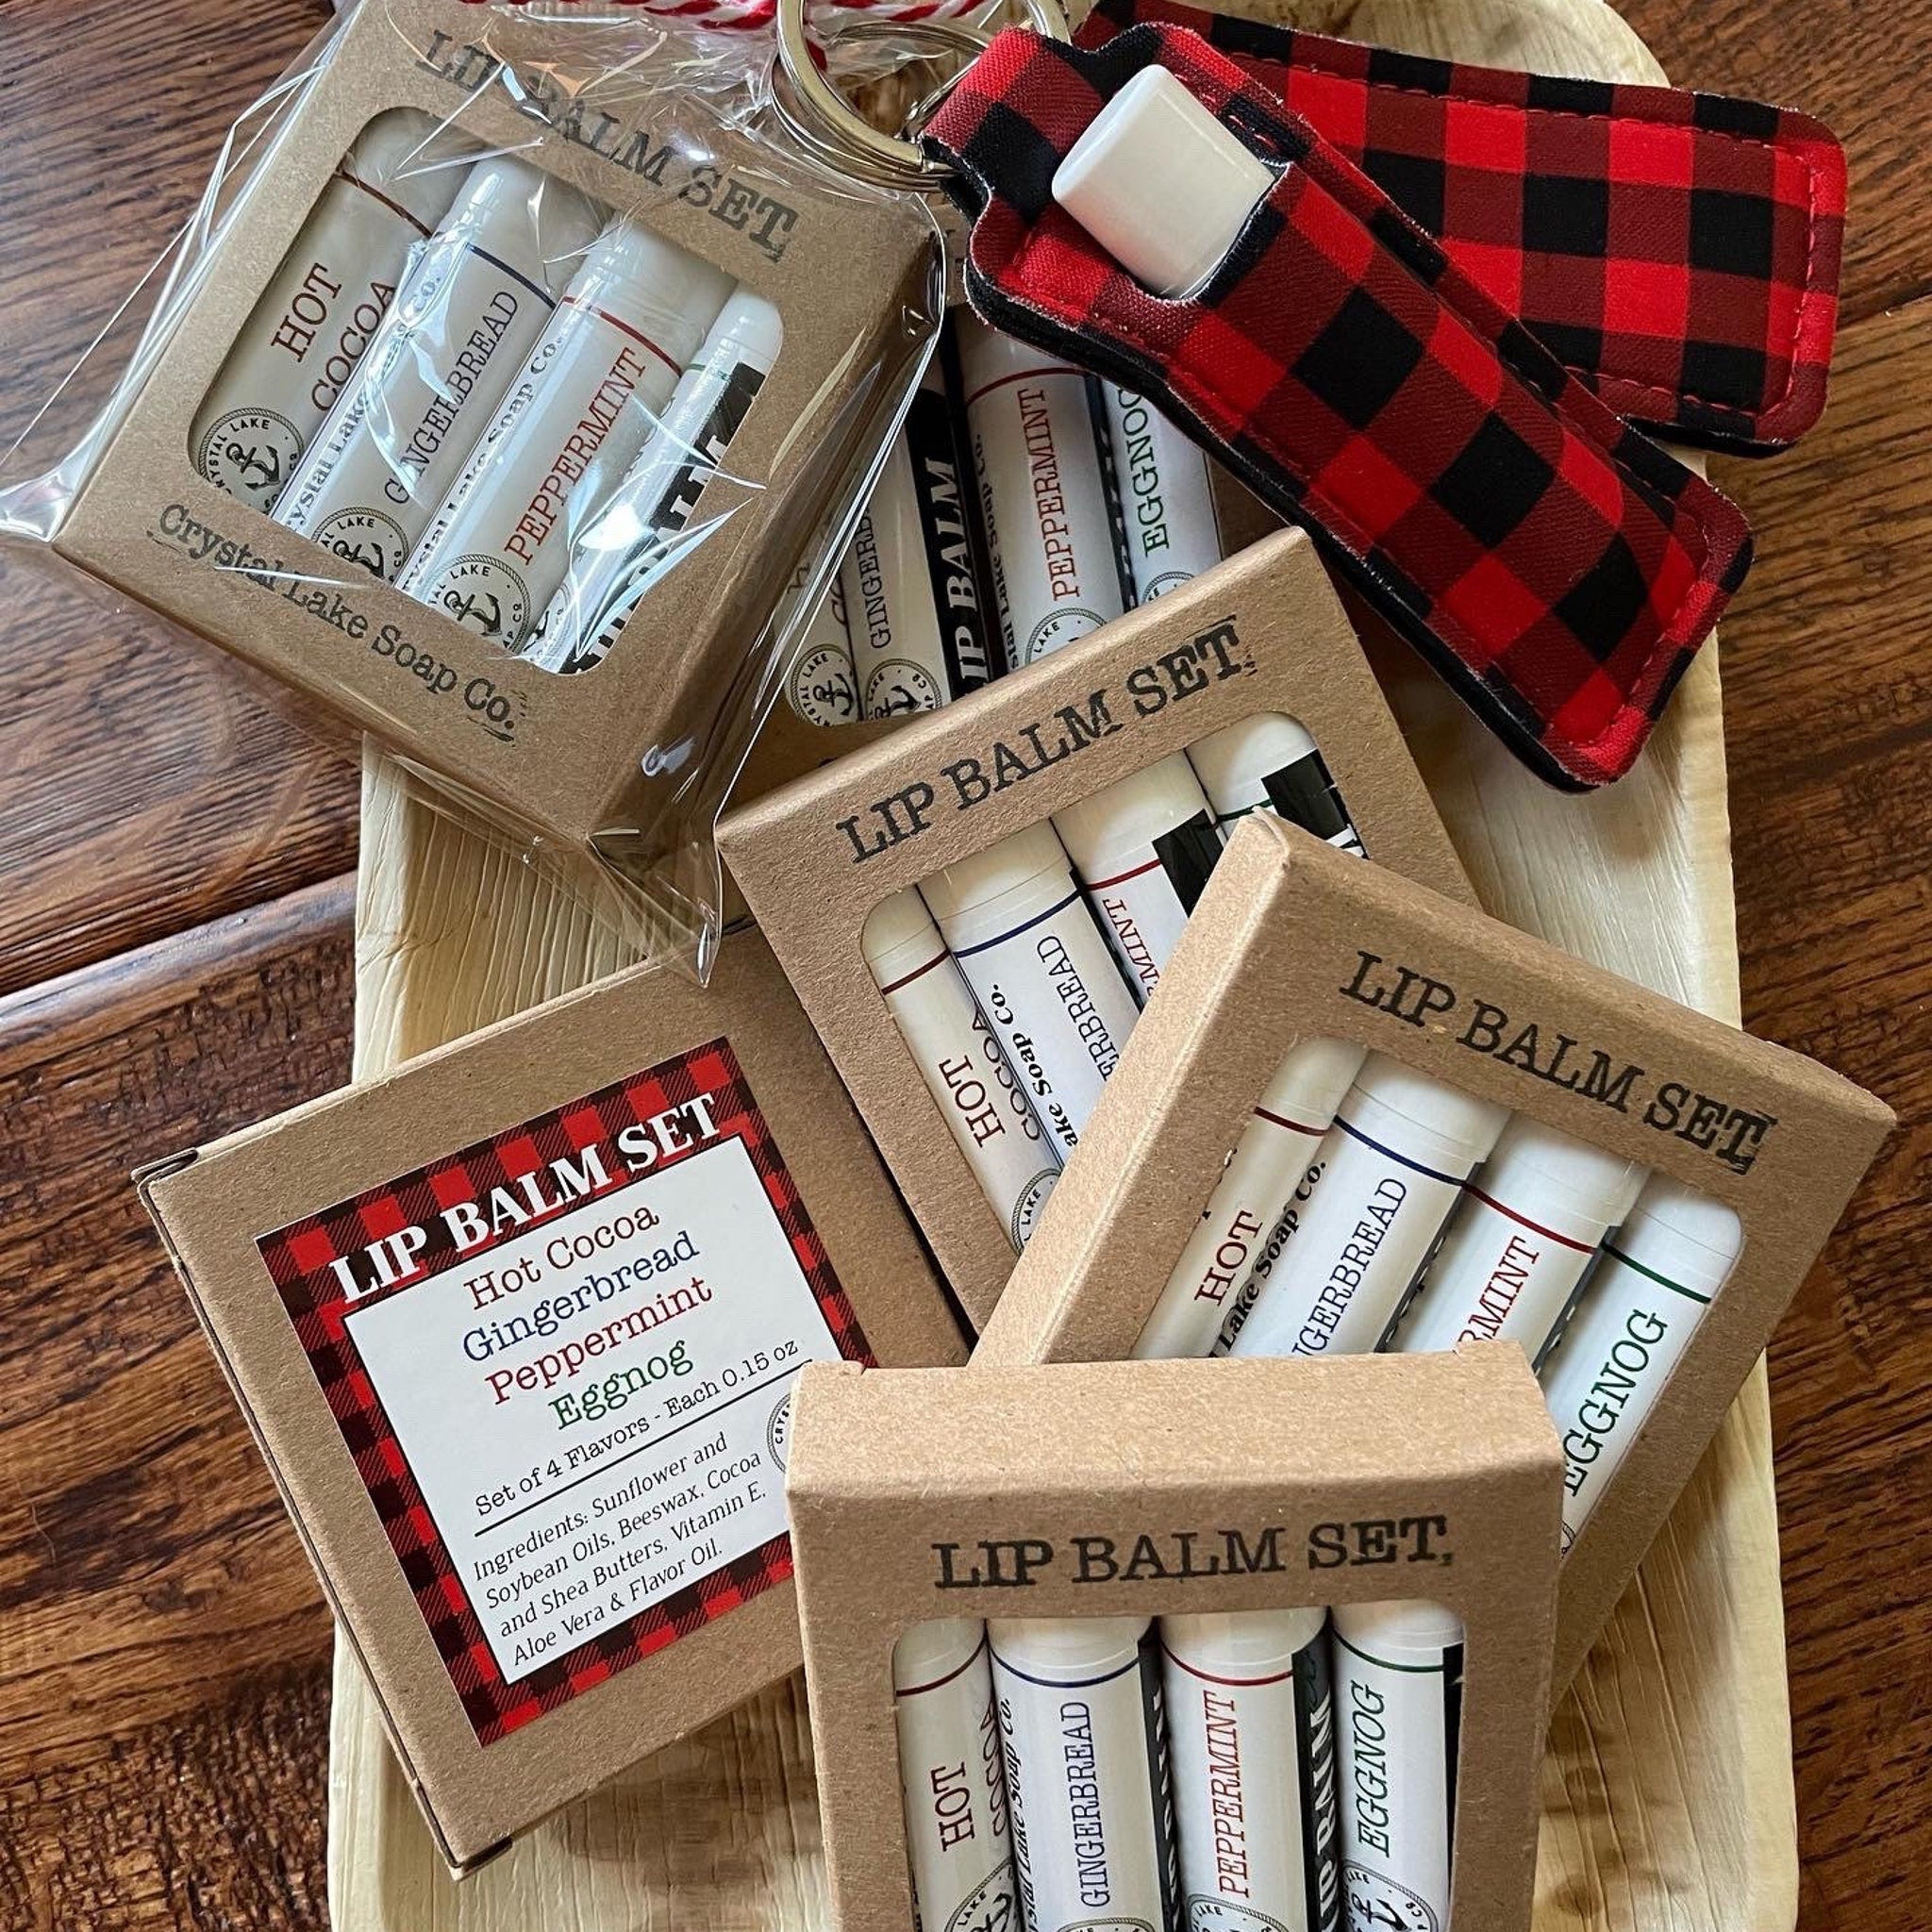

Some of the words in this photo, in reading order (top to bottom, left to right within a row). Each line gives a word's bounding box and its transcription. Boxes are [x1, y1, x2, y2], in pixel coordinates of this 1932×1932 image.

[678, 164, 799, 262] SET
[271, 262, 342, 363] HOT
[311, 282, 396, 411] COCOA
[229, 418, 271, 432] LAKE
[384, 291, 519, 506] GNGERBREAD
[504, 346, 646, 566] PEPPERMINT
[337, 516, 375, 530] LAKE
[925, 457, 977, 613] BALM
[1018, 388, 1080, 602] PEPPERMINT
[159, 504, 285, 591] Crystal
[283, 578, 369, 640] Lake
[372, 624, 458, 694] Soap
[464, 677, 516, 730] Co.
[450, 564, 491, 579] LAKE
[1034, 622, 1060, 653] LAKE
[836, 780, 935, 864] LIP
[941, 689, 1124, 810] BALM
[991, 983, 1015, 1025] Co.
[1012, 1032, 1054, 1097] Soap
[1036, 935, 1120, 1082] ERBREAD
[1339, 949, 1457, 1028] LIP
[1456, 998, 1645, 1114] BALM
[1642, 1081, 1778, 1174] SET
[938, 1054, 1007, 1148] HOT
[972, 1006, 1041, 1142] COCOA
[1047, 1101, 1078, 1148] ake
[329, 1225, 428, 1305] LIP
[440, 1144, 613, 1254] BALM
[617, 1092, 722, 1174] SET
[462, 1255, 541, 1311] Hot
[546, 1203, 660, 1272] Cocoa
[1022, 1189, 1041, 1226] LAKE
[1193, 1209, 1263, 1307] HOT
[1255, 1208, 1301, 1279] Soap
[1295, 1161, 1327, 1202] Co.
[462, 1230, 701, 1363] Gingerbread
[1291, 1177, 1407, 1357] GERBREAD
[484, 1274, 714, 1405] Peppermint
[548, 1340, 694, 1430] Eggnog
[1562, 1308, 1669, 1497] EGGNOG
[475, 1488, 516, 1516] Set
[519, 1467, 543, 1493] of
[546, 1458, 563, 1478] 4
[564, 1417, 651, 1471] Flavors
[662, 1381, 721, 1418] Each
[722, 1352, 771, 1389] 0.15
[773, 1340, 799, 1362] oz
[774, 1404, 791, 1444] CRYS
[474, 1512, 590, 1582] Ingredients:
[591, 1454, 689, 1520] Sunflower
[692, 1431, 728, 1465] and
[485, 1555, 569, 1609] Soybean
[706, 1452, 762, 1491] Cocoa
[500, 1603, 538, 1638] and
[541, 1578, 590, 1616] Shea
[671, 1494, 744, 1542] Vitamin
[931, 1539, 1055, 1589] LIP
[1070, 1527, 1287, 1584] BALM
[513, 1631, 558, 1666] Aloe
[560, 1608, 606, 1637] Vera
[609, 1591, 625, 1612] &
[628, 1557, 686, 1602] Flavor
[691, 1537, 723, 1567] Oil.
[930, 1761, 975, 1853] HOT
[1006, 1741, 1024, 1808] Soap
[1059, 1701, 1110, 1907] GINGERBREAD
[1203, 1690, 1249, 1899] PEPPERMINT
[1351, 1679, 1390, 1858] EGGNOG
[957, 1890, 988, 1926] LAKE
